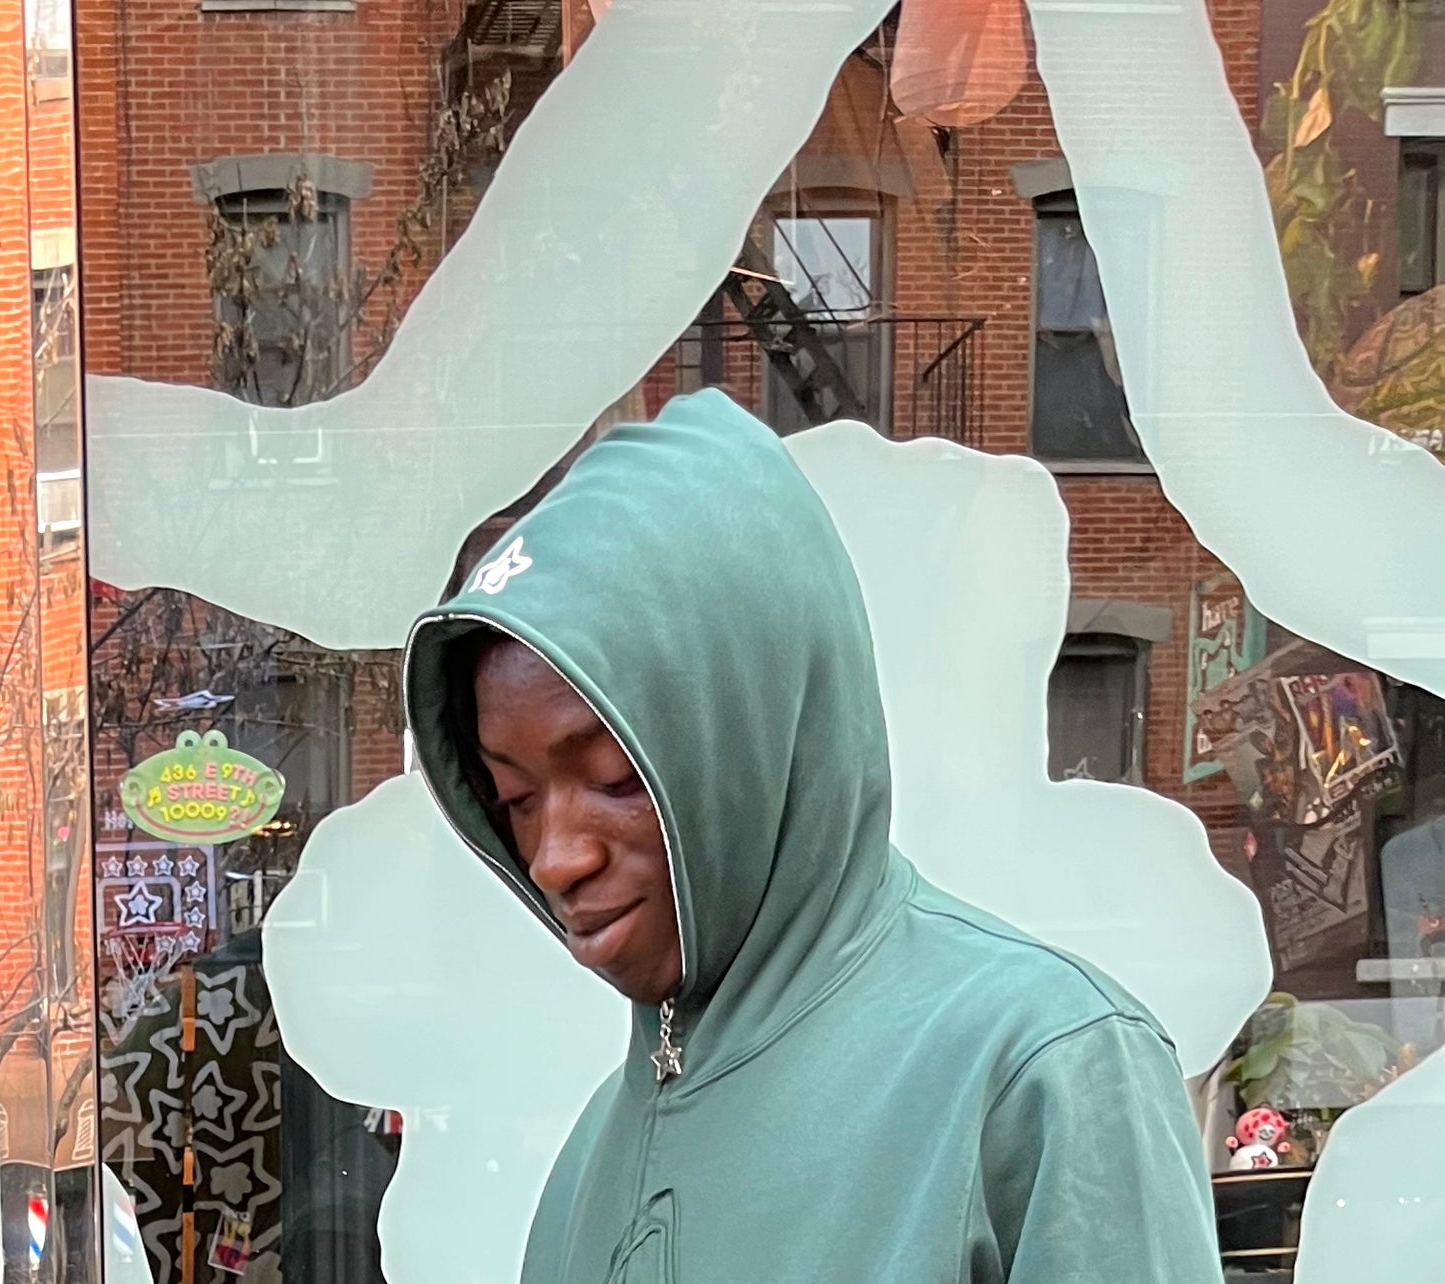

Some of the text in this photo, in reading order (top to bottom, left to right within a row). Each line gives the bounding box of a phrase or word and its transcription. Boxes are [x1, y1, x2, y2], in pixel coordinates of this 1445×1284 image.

[160, 763, 257, 786] 436 E 9TH
[167, 783, 242, 800] STREET
